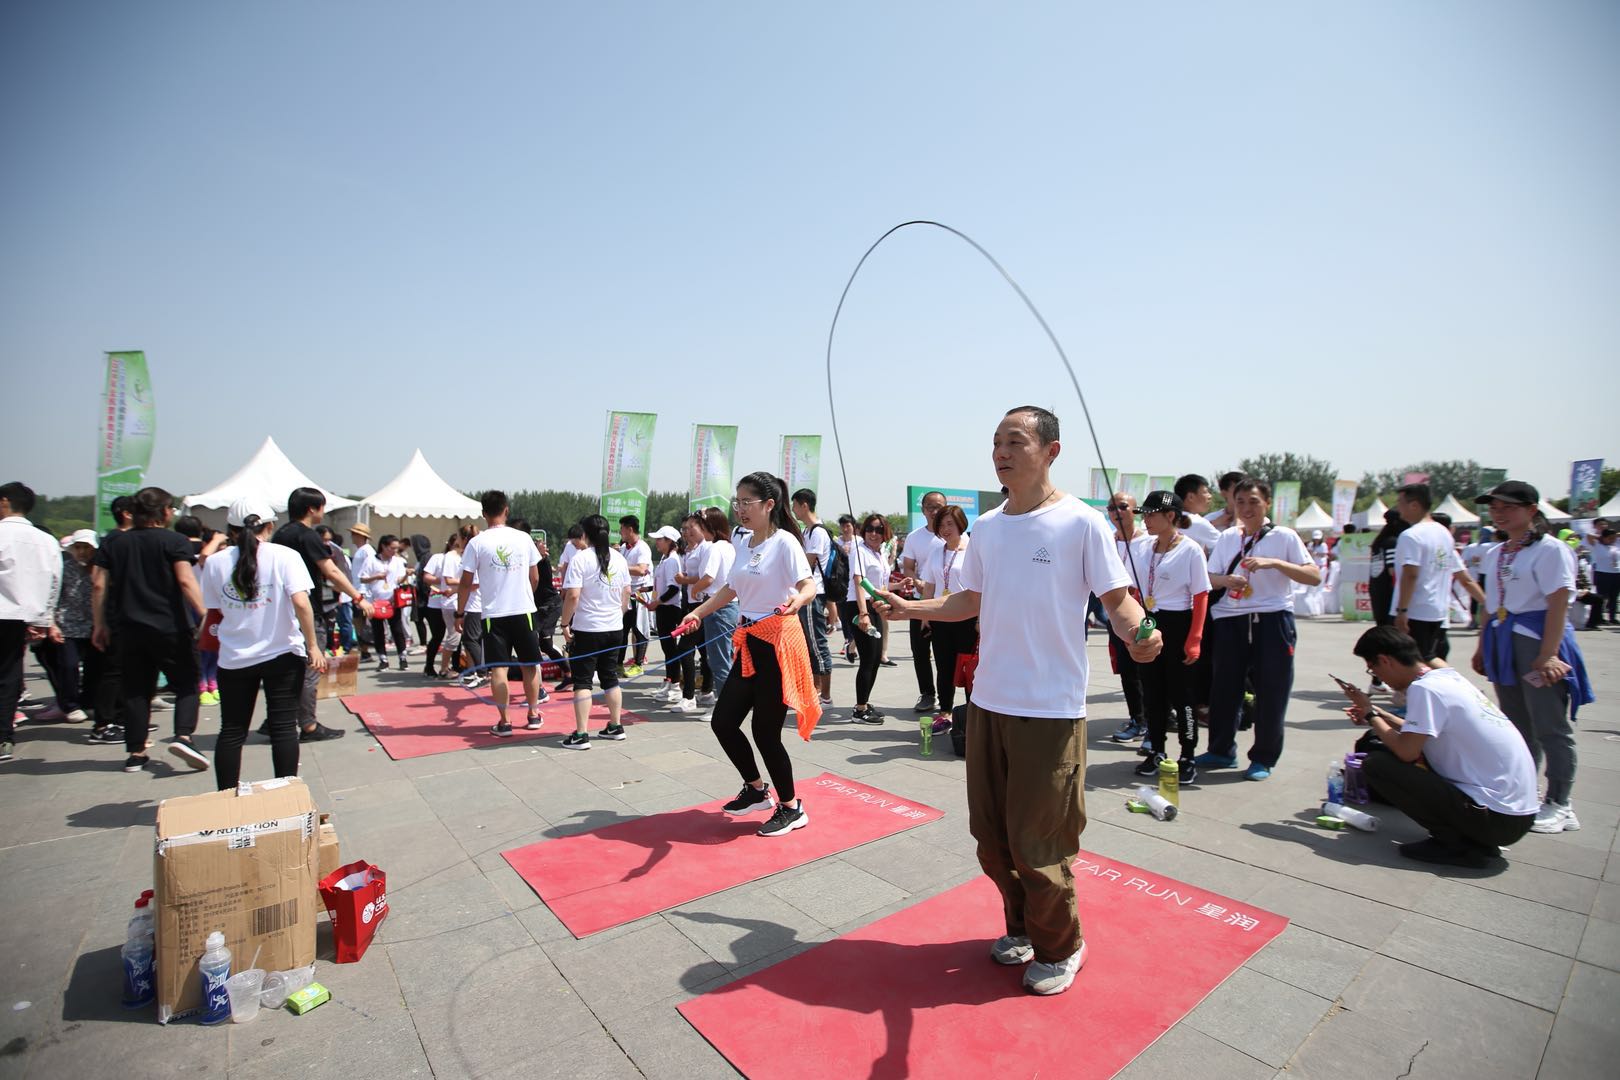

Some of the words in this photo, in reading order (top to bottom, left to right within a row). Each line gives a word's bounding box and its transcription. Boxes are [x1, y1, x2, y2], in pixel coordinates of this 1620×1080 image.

[815, 779, 858, 796] STAR
[855, 792, 894, 808] RUN
[1070, 857, 1122, 881] TAR
[1123, 877, 1192, 906] RUN
[1194, 902, 1261, 931] 星润
